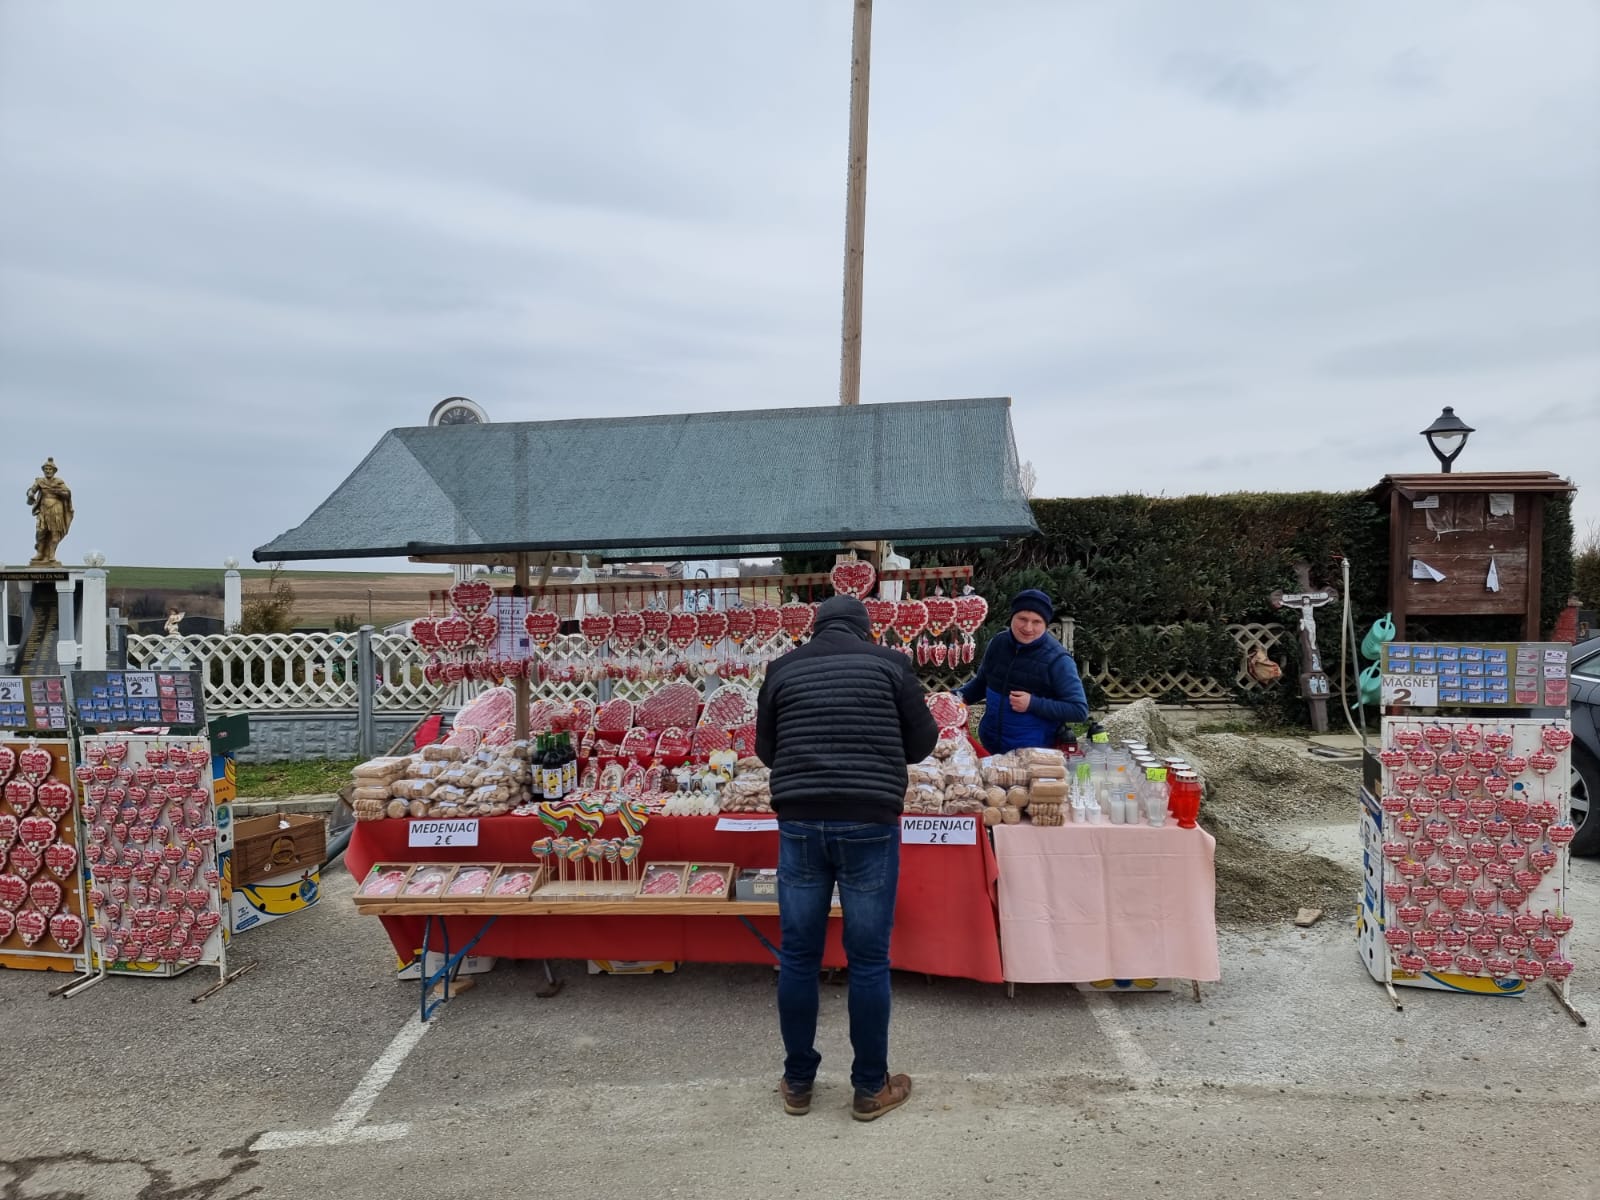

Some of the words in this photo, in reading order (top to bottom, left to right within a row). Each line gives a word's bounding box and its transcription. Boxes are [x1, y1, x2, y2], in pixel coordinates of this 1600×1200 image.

[130, 682, 143, 695] 2
[1382, 678, 1437, 688] MAGNET
[1, 687, 12, 700] 2
[1393, 688, 1412, 705] 2
[411, 822, 477, 834] MEDENJACI
[903, 819, 974, 831] MEDENJACI
[434, 835, 442, 846] 2
[445, 834, 453, 845] €
[929, 832, 937, 843] 2
[940, 832, 949, 843] €
